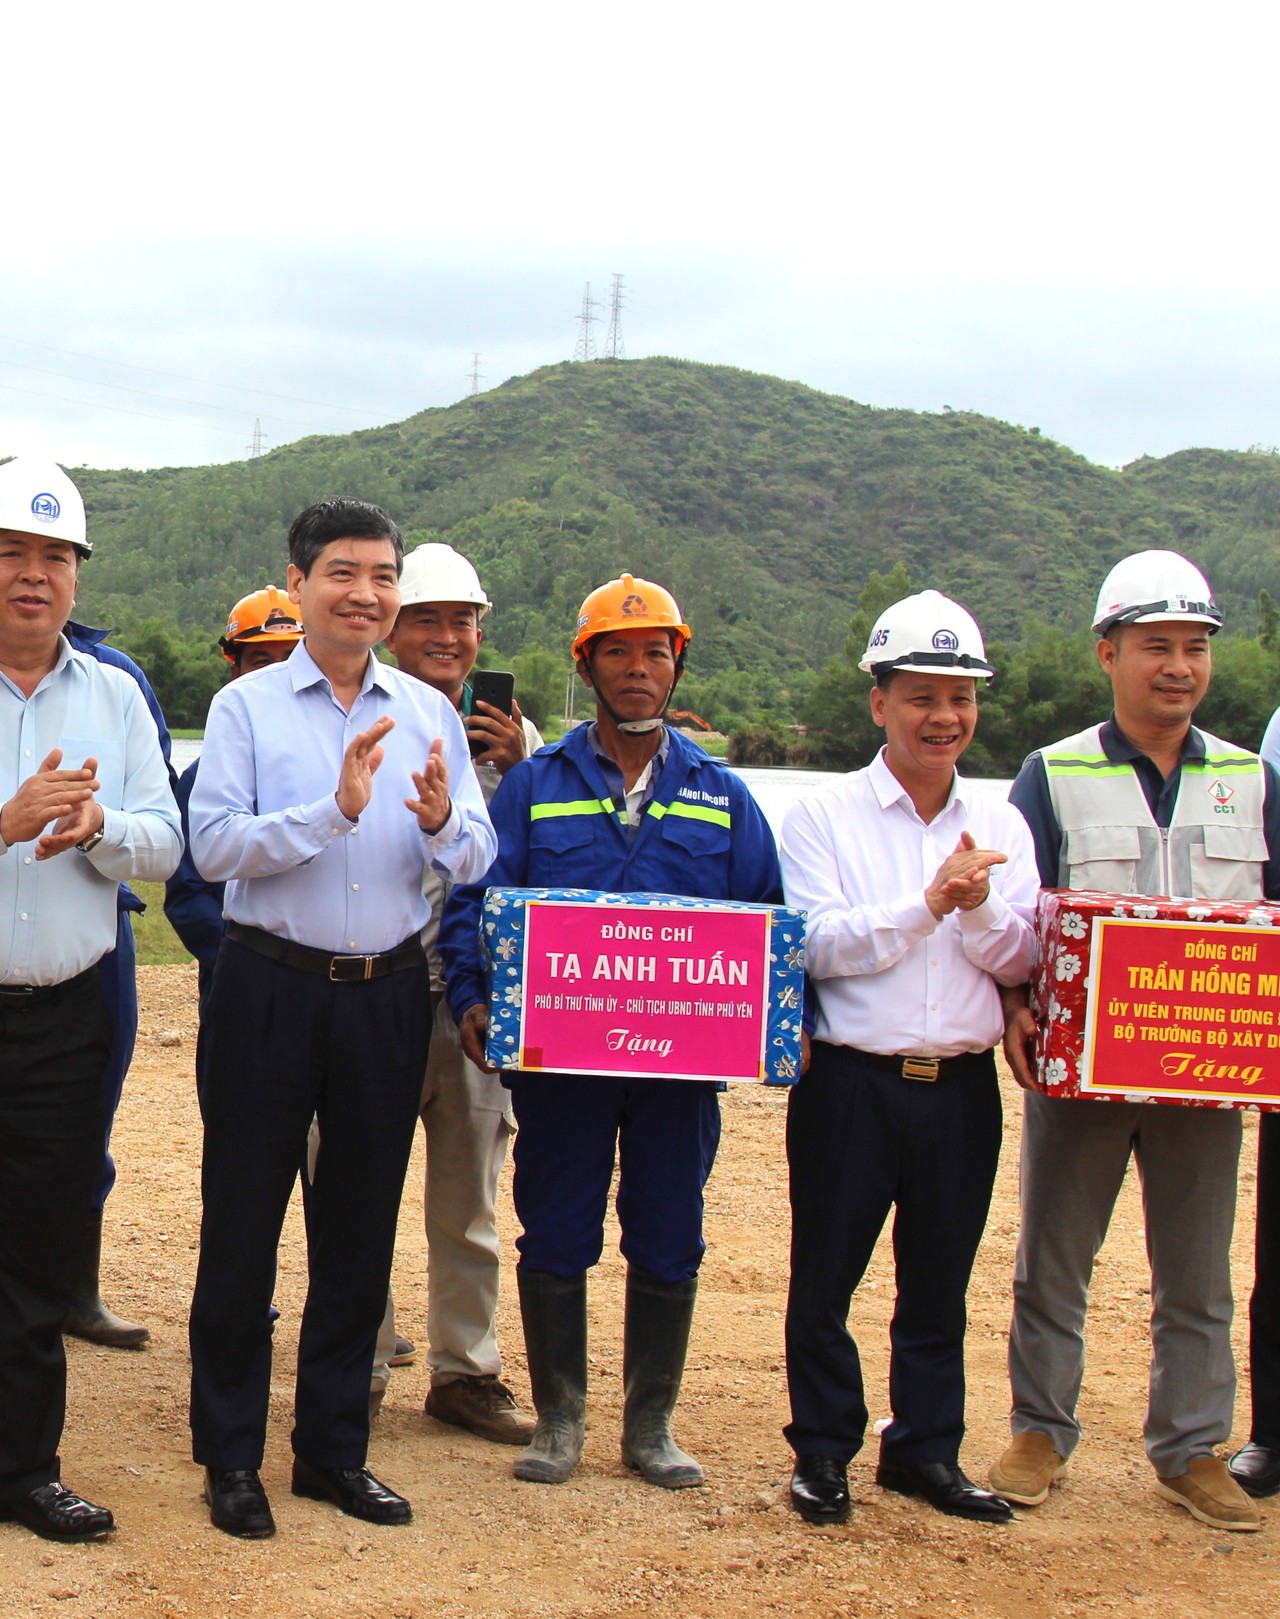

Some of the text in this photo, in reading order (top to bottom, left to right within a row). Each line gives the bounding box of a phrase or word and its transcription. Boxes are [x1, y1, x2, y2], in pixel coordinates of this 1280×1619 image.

[1214, 805, 1235, 814] CC1
[600, 920, 694, 942] ĐỒNG CHÍ
[1185, 939, 1258, 962] ĐỒNG CHÍ
[546, 950, 748, 986] TẠ ANH TUẤN
[1128, 960, 1184, 991] TRẦN
[1190, 964, 1251, 995] HỒNG
[535, 993, 551, 1009] PHÓ
[554, 993, 563, 1010] BÍ
[566, 996, 583, 1010] THƯ
[584, 994, 604, 1011] TỈNH
[606, 994, 618, 1012] ỦY
[627, 996, 644, 1014] CHỦ
[647, 1000, 666, 1016] TỊCH
[668, 1001, 692, 1015] UBND
[694, 998, 714, 1017] TỈNH
[716, 1001, 734, 1017] PHÚ
[737, 1002, 752, 1018] YÊN
[1108, 998, 1129, 1017] ỦY
[1134, 1002, 1169, 1019] VIÊN
[1174, 1005, 1225, 1022] TRUNG
[1230, 1008, 1273, 1025] ƯƠNG
[606, 1028, 674, 1058] Tặng
[1114, 1023, 1135, 1043] BỘ
[1140, 1024, 1202, 1044] TRƯỞNG
[1206, 1029, 1228, 1048] BỘ
[1232, 1030, 1263, 1048] XÂY
[1160, 1052, 1265, 1086] Tặng
